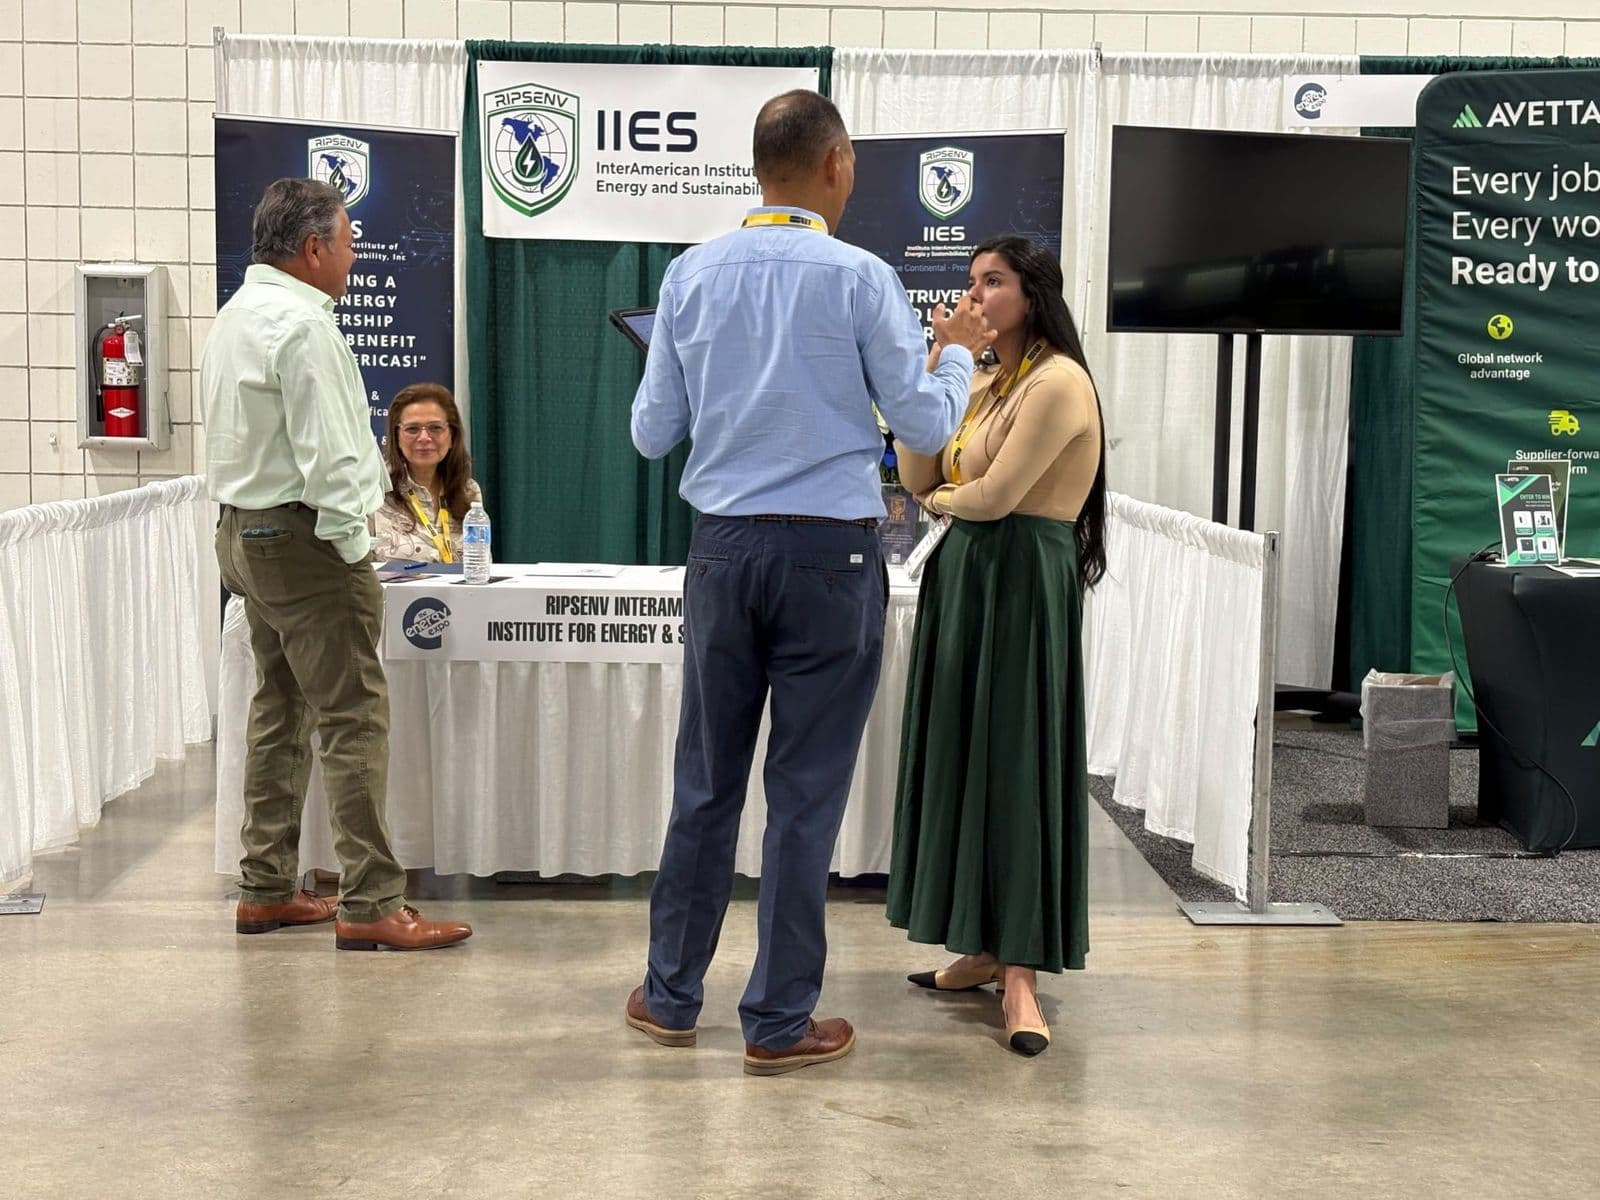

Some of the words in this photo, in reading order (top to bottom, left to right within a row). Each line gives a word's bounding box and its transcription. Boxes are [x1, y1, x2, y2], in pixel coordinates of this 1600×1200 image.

[495, 91, 568, 107] RIPSENV
[1486, 100, 1600, 127] AVETTA
[597, 110, 697, 152] IIES
[315, 137, 363, 149] RIPSENV
[926, 150, 968, 160] RIPSENV
[596, 161, 700, 176] InterAmerican
[704, 163, 755, 177] Institu
[596, 180, 648, 196] Energy
[651, 181, 678, 194] and
[1452, 166, 1541, 202] Every
[1549, 161, 1600, 201] job
[350, 220, 363, 239] S
[923, 226, 966, 241] IIES
[1452, 211, 1542, 246] Every
[1552, 215, 1600, 238] wo
[388, 243, 398, 251] of
[904, 263, 946, 272] Continental
[1451, 254, 1557, 291] Ready
[1565, 256, 1600, 283] to
[384, 275, 397, 289] A
[345, 333, 417, 348] BENEFIT
[1457, 353, 1494, 364] Global
[1496, 352, 1543, 364] network
[1470, 367, 1531, 380] advantage
[371, 390, 380, 400] &
[1570, 465, 1588, 475] rm
[546, 594, 609, 616] RIPSENV
[614, 596, 683, 617] INTERAM
[405, 606, 448, 638] energy
[428, 620, 450, 636] expo
[487, 621, 563, 642] INSTITUTE
[568, 622, 596, 643] FOR
[601, 623, 657, 644] ENERGY
[661, 623, 674, 644] &
